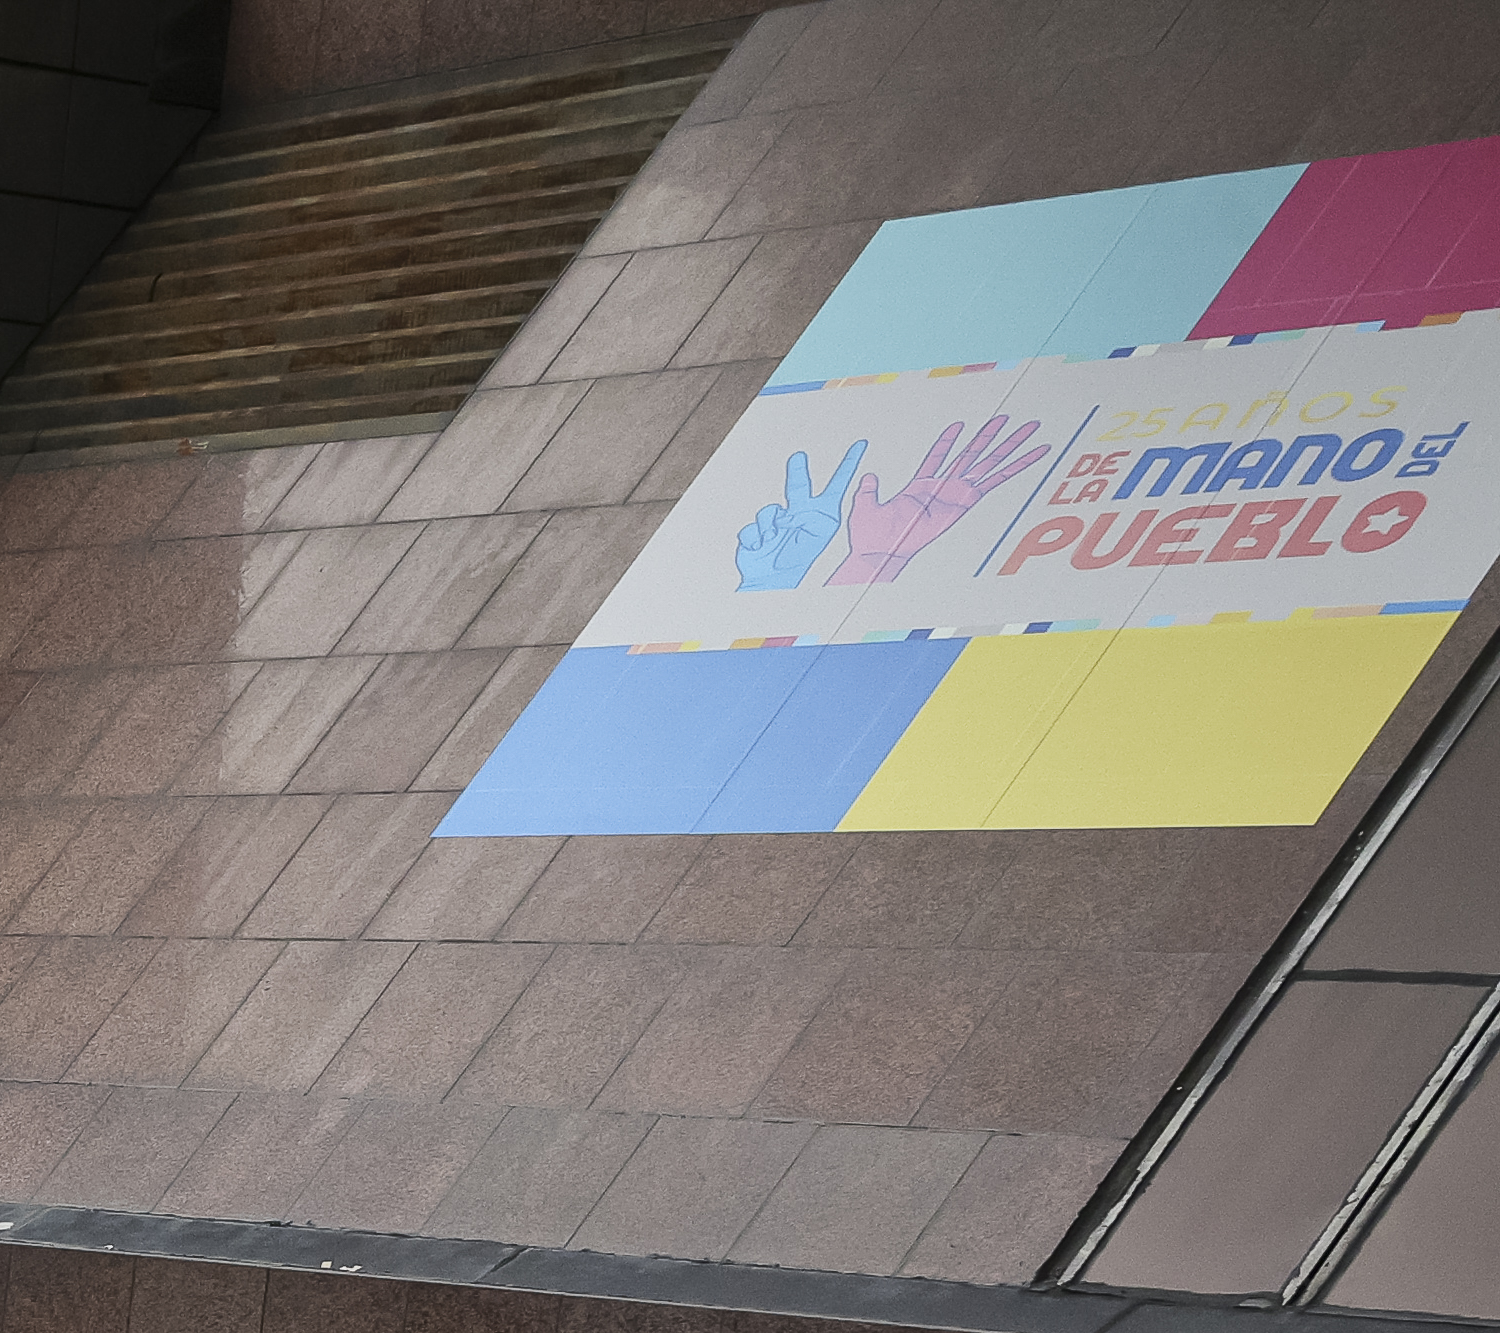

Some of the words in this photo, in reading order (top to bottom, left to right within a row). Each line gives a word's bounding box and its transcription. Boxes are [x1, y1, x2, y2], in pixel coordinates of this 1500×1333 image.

[1097, 405, 1167, 442] 25
[1066, 451, 1131, 479] DE
[1112, 428, 1405, 500] MANO
[1399, 421, 1470, 478] DEL
[1048, 477, 1109, 506] LA
[997, 490, 1427, 576] PUEBLO
